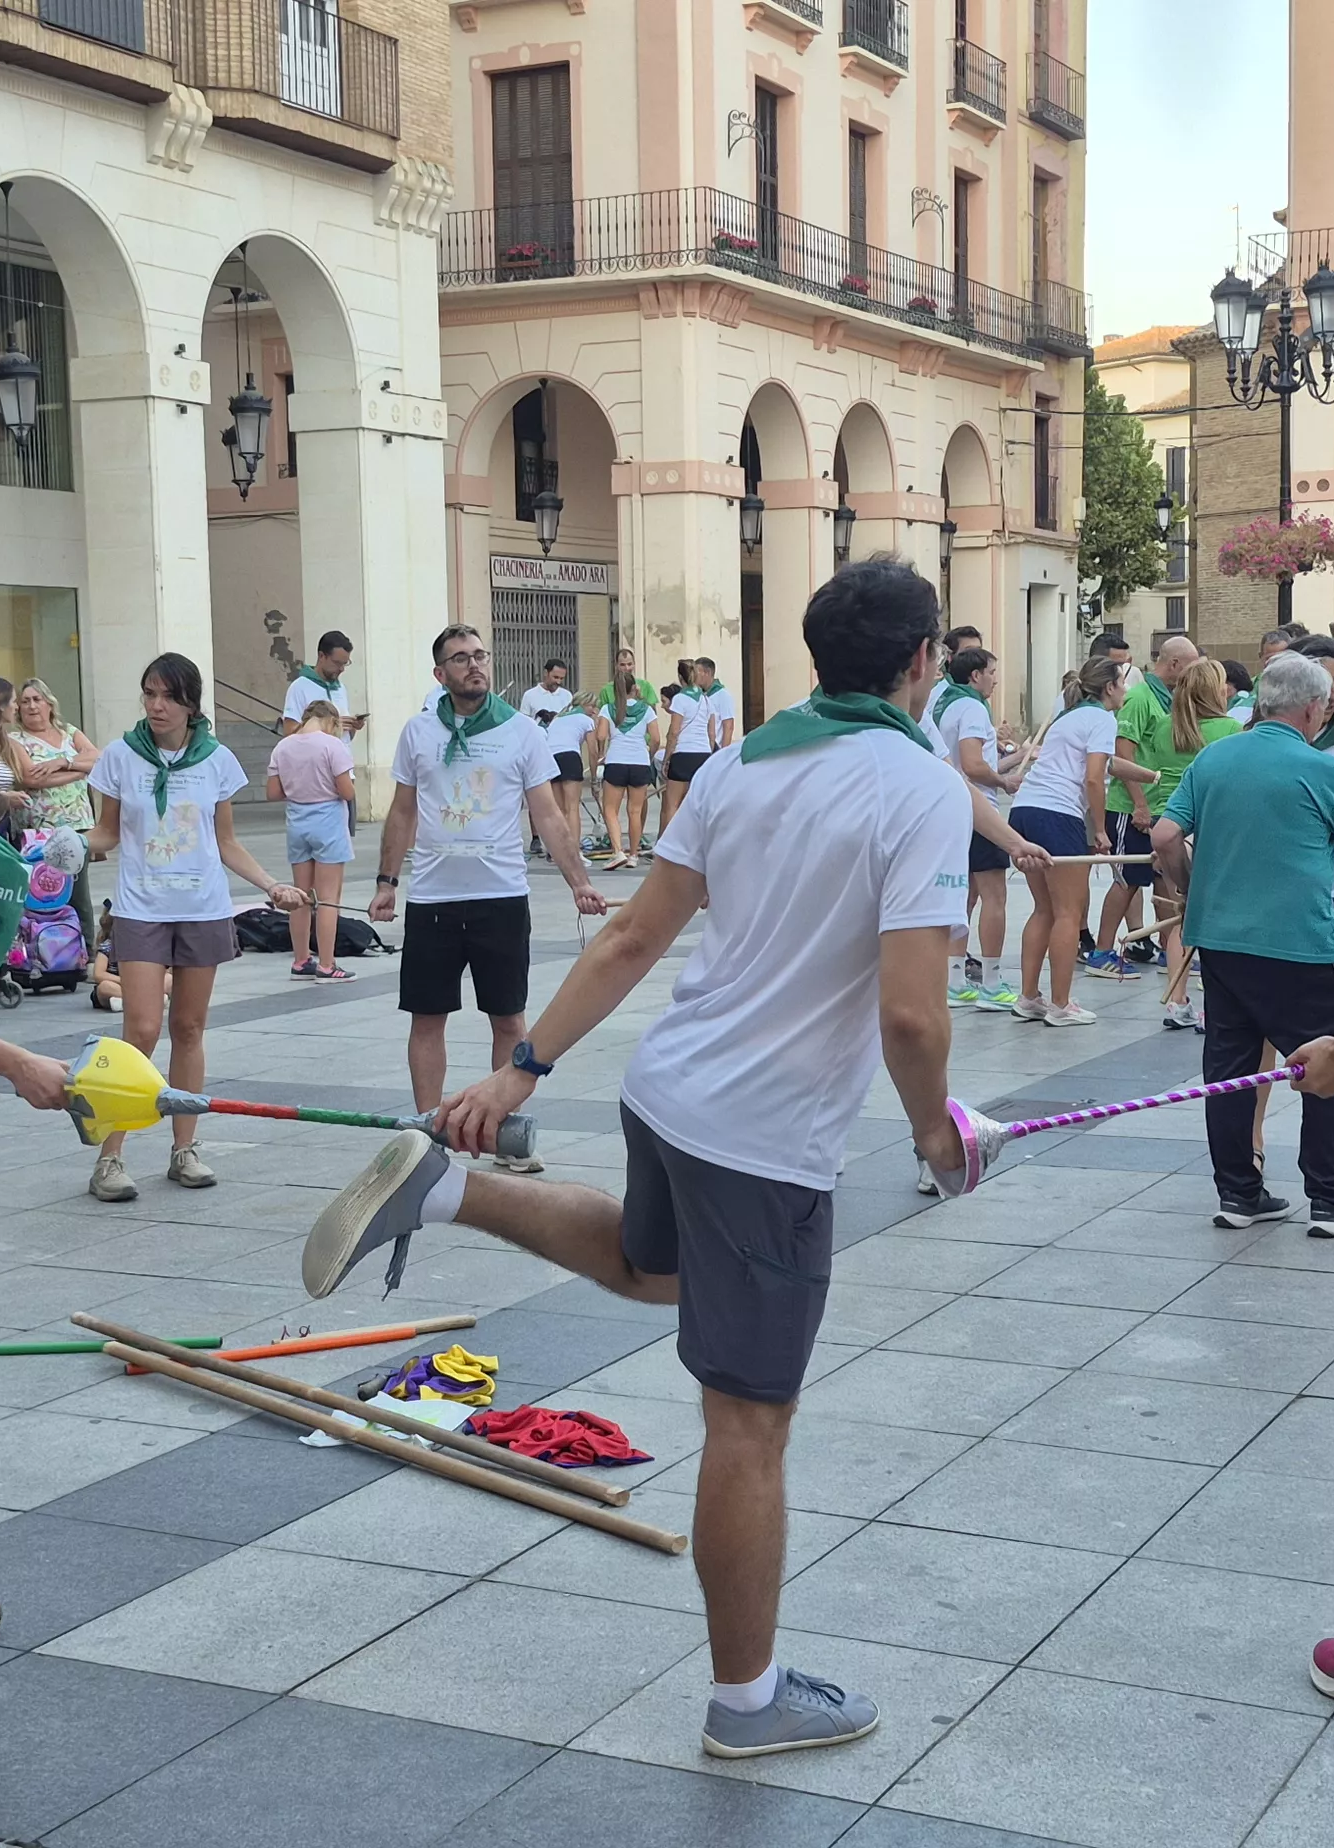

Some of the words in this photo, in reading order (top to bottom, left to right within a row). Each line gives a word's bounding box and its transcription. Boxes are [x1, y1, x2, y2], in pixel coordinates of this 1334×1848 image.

[493, 558, 544, 579] CHACINERIA
[558, 564, 587, 582] AMADO
[589, 566, 605, 583] ARA
